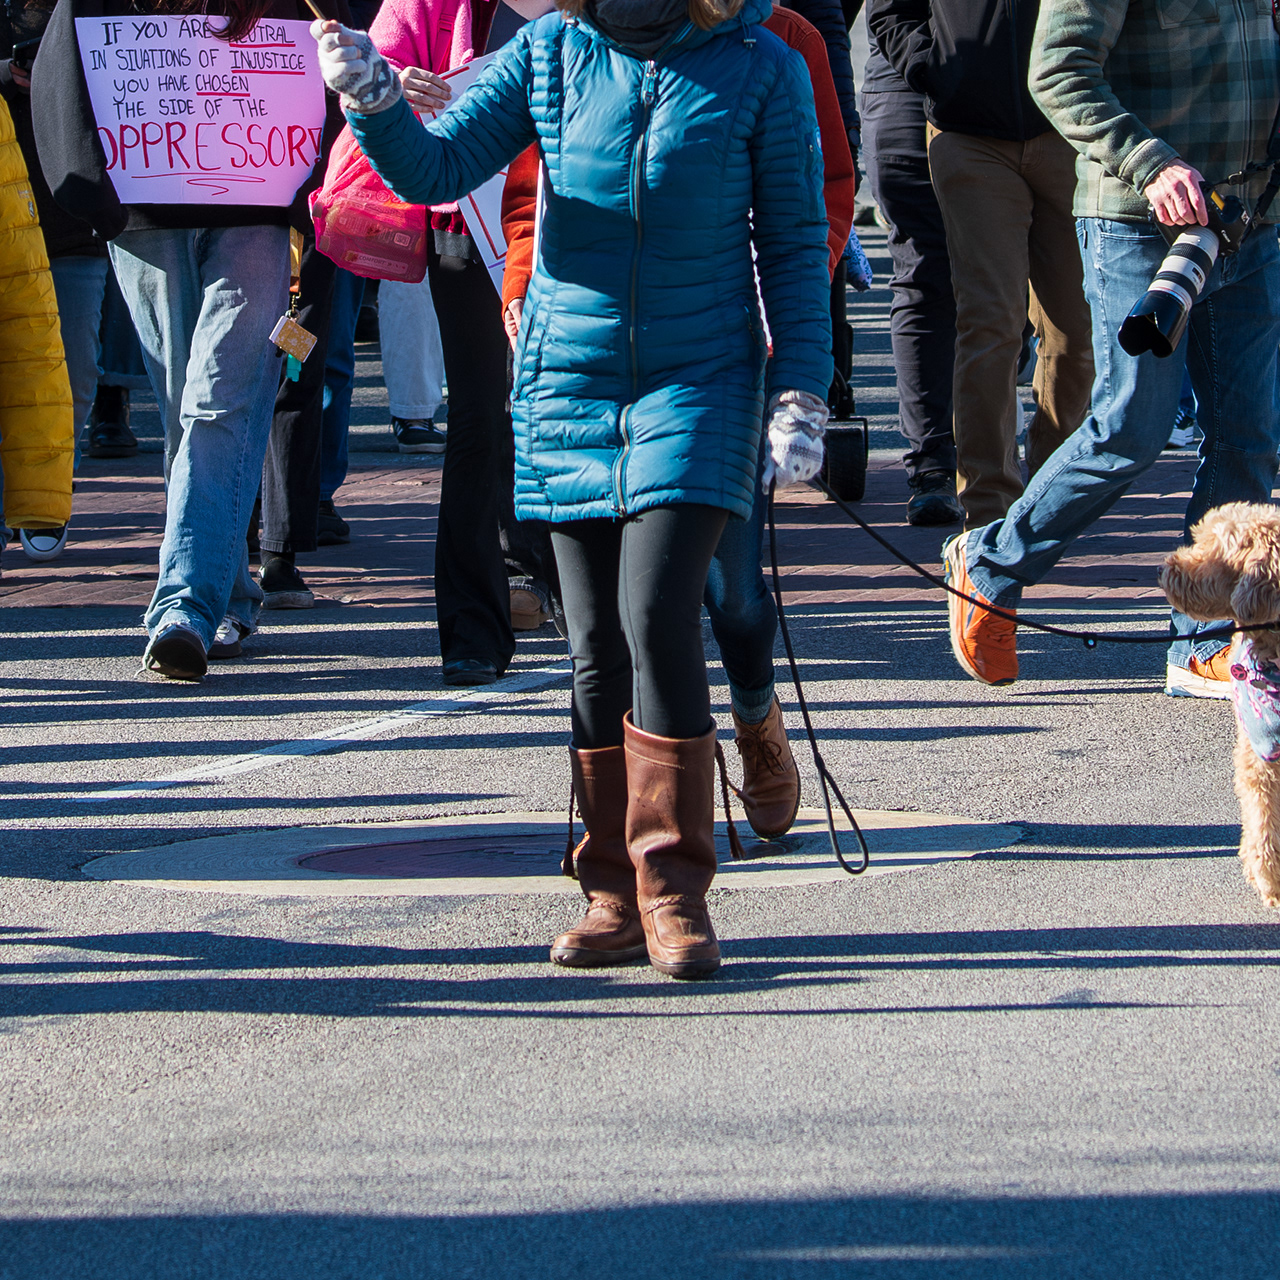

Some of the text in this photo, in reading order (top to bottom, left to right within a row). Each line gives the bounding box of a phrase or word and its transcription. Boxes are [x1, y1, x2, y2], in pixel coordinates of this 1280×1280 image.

[101, 22, 123, 46] IF
[131, 21, 168, 41] YOU
[178, 19, 213, 39] ARE
[90, 50, 107, 71] IN
[199, 49, 219, 68] OF
[229, 51, 306, 69] INJUSTICE
[158, 75, 190, 92] HAVE
[196, 74, 249, 93] CHOSEN
[113, 98, 268, 120] THE SIDE OF THE
